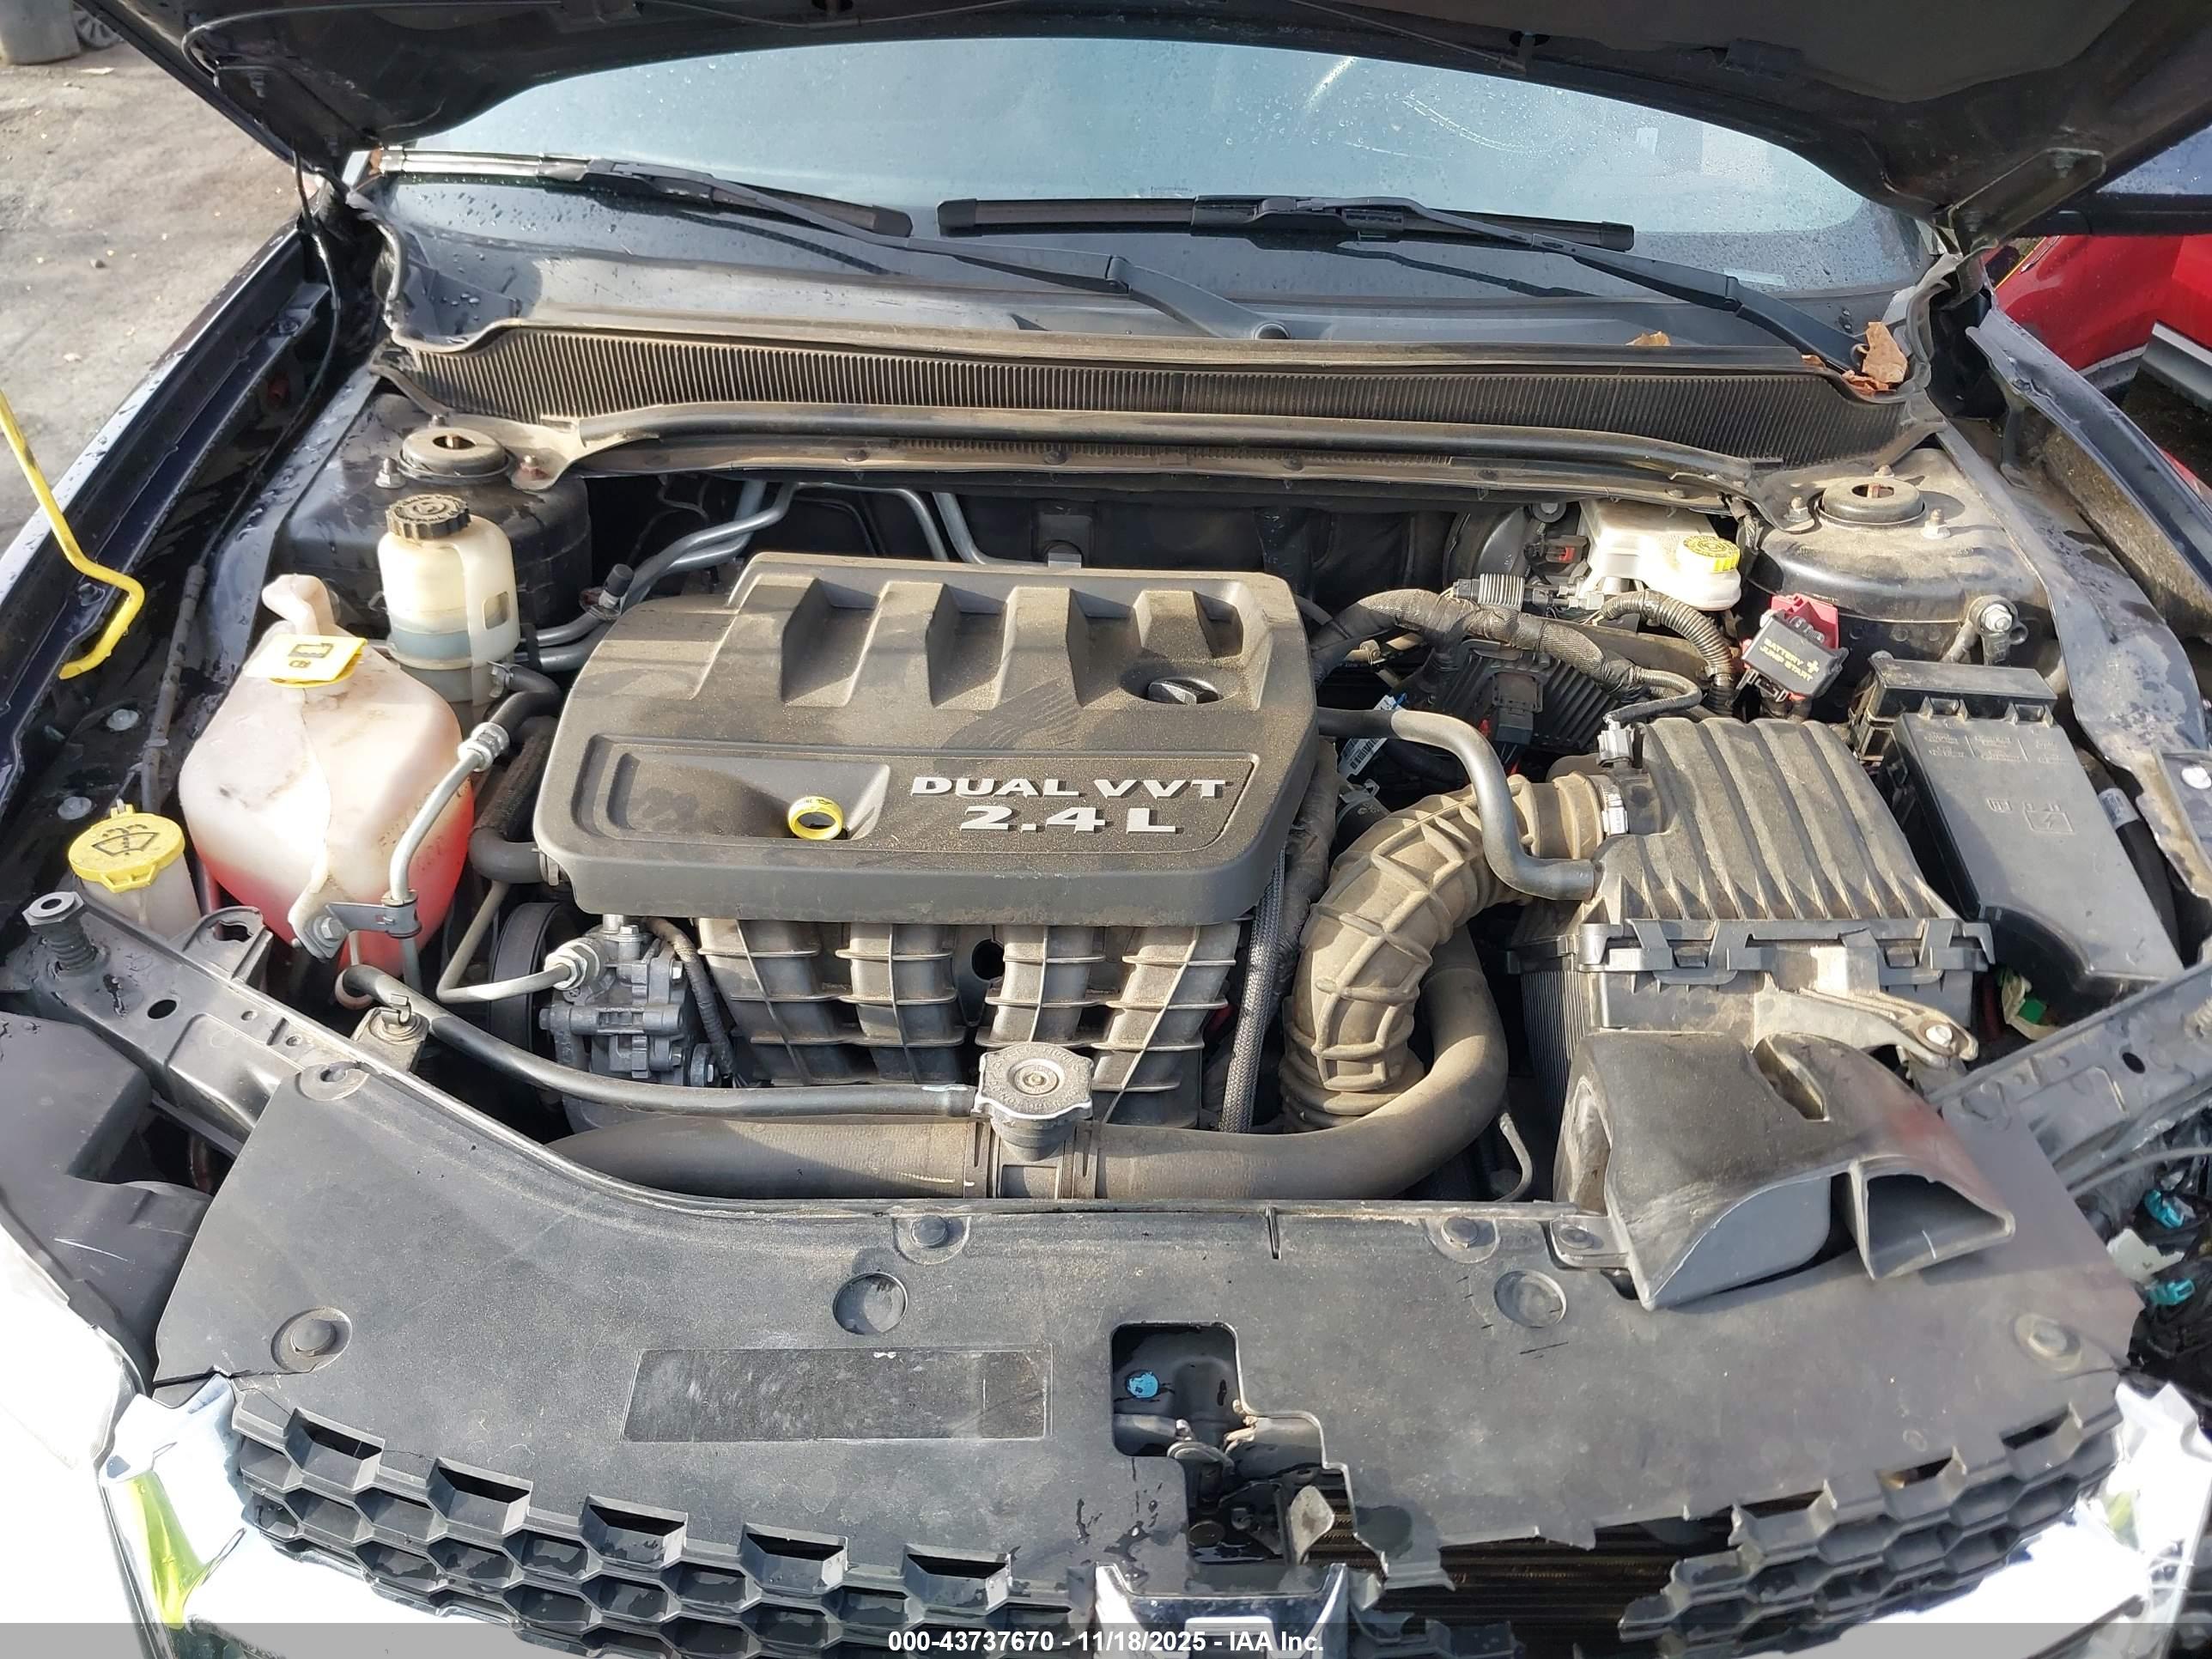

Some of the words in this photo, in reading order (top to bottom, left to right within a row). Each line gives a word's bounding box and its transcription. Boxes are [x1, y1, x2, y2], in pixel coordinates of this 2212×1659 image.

[1759, 645, 1784, 664] JUMP
[1784, 661, 1814, 683] START
[1763, 637, 1804, 666] BATTERY
[909, 775, 1080, 799] DUAL
[1092, 778, 1226, 799] VVT
[958, 805, 1107, 834] 2.4
[1126, 807, 1176, 835] L
